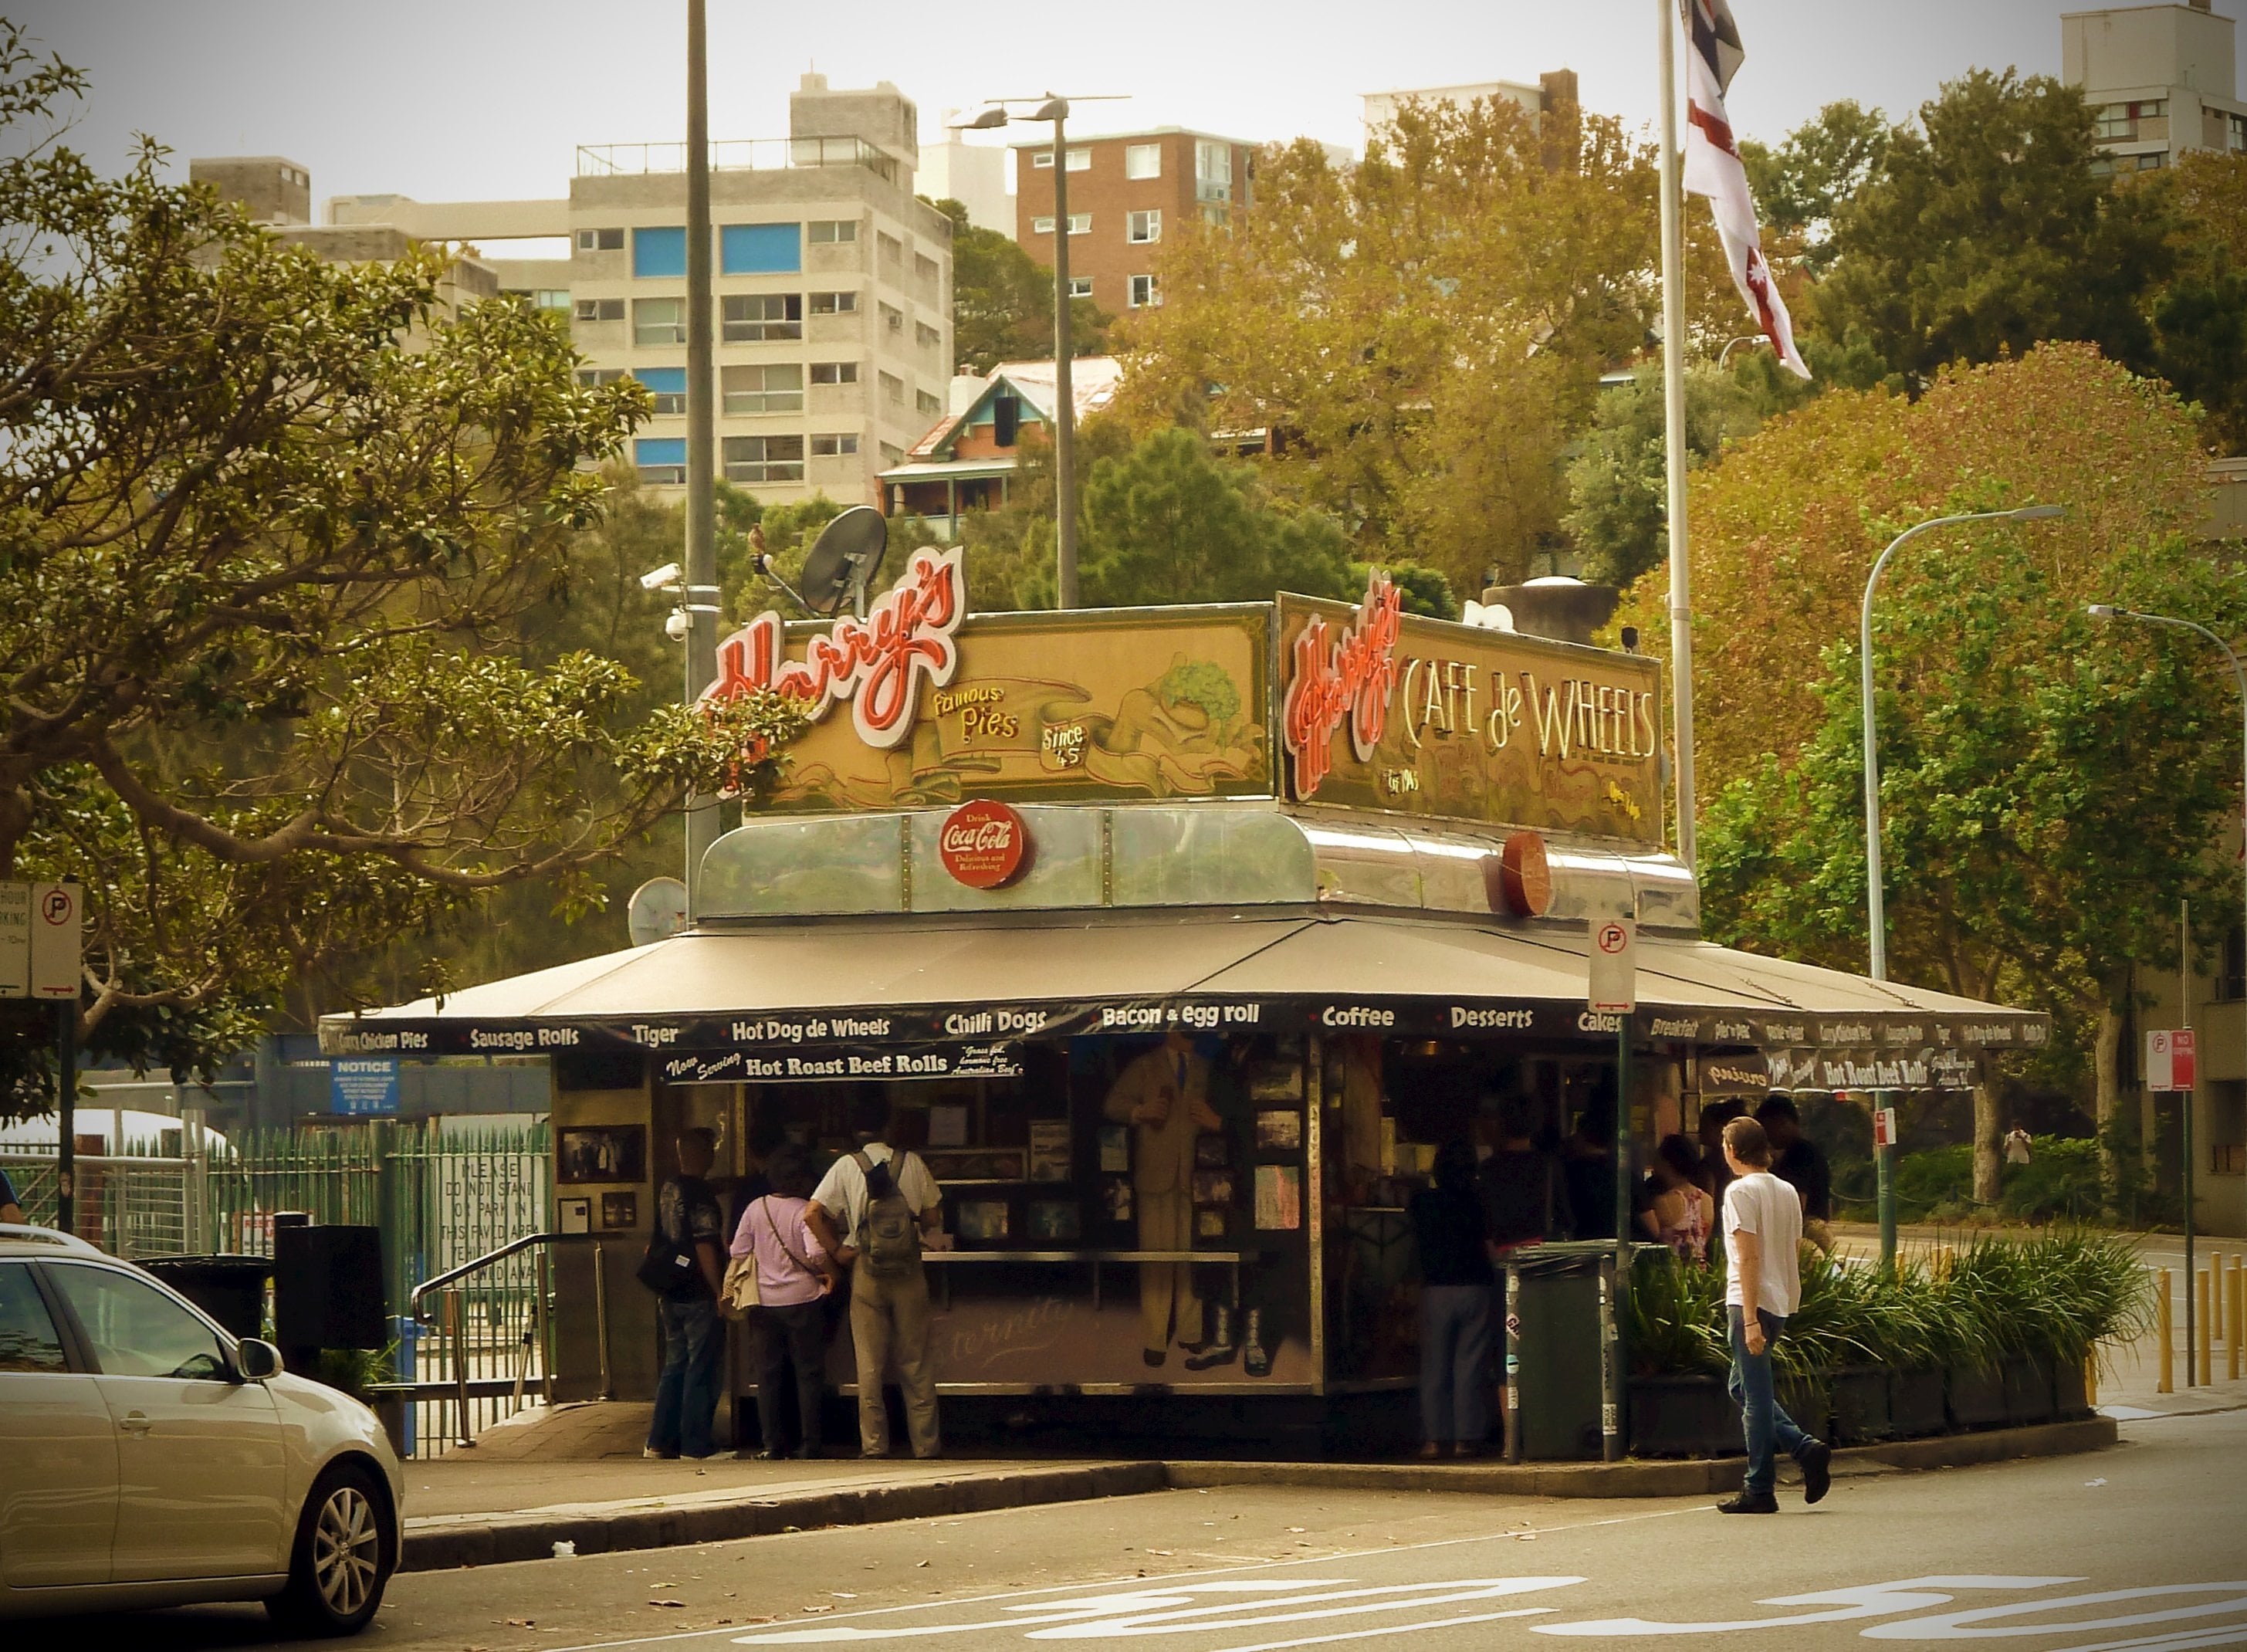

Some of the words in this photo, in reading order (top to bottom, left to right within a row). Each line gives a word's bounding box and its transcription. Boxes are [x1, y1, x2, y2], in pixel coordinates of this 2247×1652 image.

[933, 687, 1003, 716] Famous
[1403, 658, 1479, 749] CAFE
[1491, 671, 1521, 748] de
[1521, 670, 1655, 759] WHEELS
[962, 706, 1017, 744] Pies
[1043, 725, 1088, 750] Since
[966, 814, 991, 823] Drink
[955, 855, 990, 863] Delicious
[991, 853, 1005, 862] and
[0, 912, 25, 926] KING
[944, 1014, 992, 1035] Chilli
[997, 1010, 1047, 1034] Dogs
[1102, 1007, 1162, 1027] Bacon
[1166, 1008, 1179, 1022] &
[1181, 1004, 1220, 1027] egg
[1223, 1003, 1260, 1024] roll
[1321, 1005, 1396, 1027] Coffee
[1450, 1006, 1533, 1030] Desserts
[1577, 1012, 1623, 1034] Cakes
[400, 1031, 428, 1049] Pies
[470, 1028, 534, 1050] Sausage
[538, 1027, 579, 1047] Rolls
[631, 1024, 679, 1048] Tiger
[732, 1021, 763, 1041] Hot
[770, 1020, 803, 1044] Dog
[806, 1018, 827, 1037] de
[831, 1017, 891, 1038] Wheels
[337, 1061, 392, 1074] NOTICE
[666, 1057, 699, 1078] Now
[696, 1052, 741, 1081] Serving
[746, 1058, 783, 1077] Hot
[787, 1057, 845, 1076] Roast
[848, 1055, 892, 1075] Beef
[895, 1055, 948, 1074] Rolls
[446, 1182, 462, 1197] DO
[469, 1182, 492, 1197] NOT
